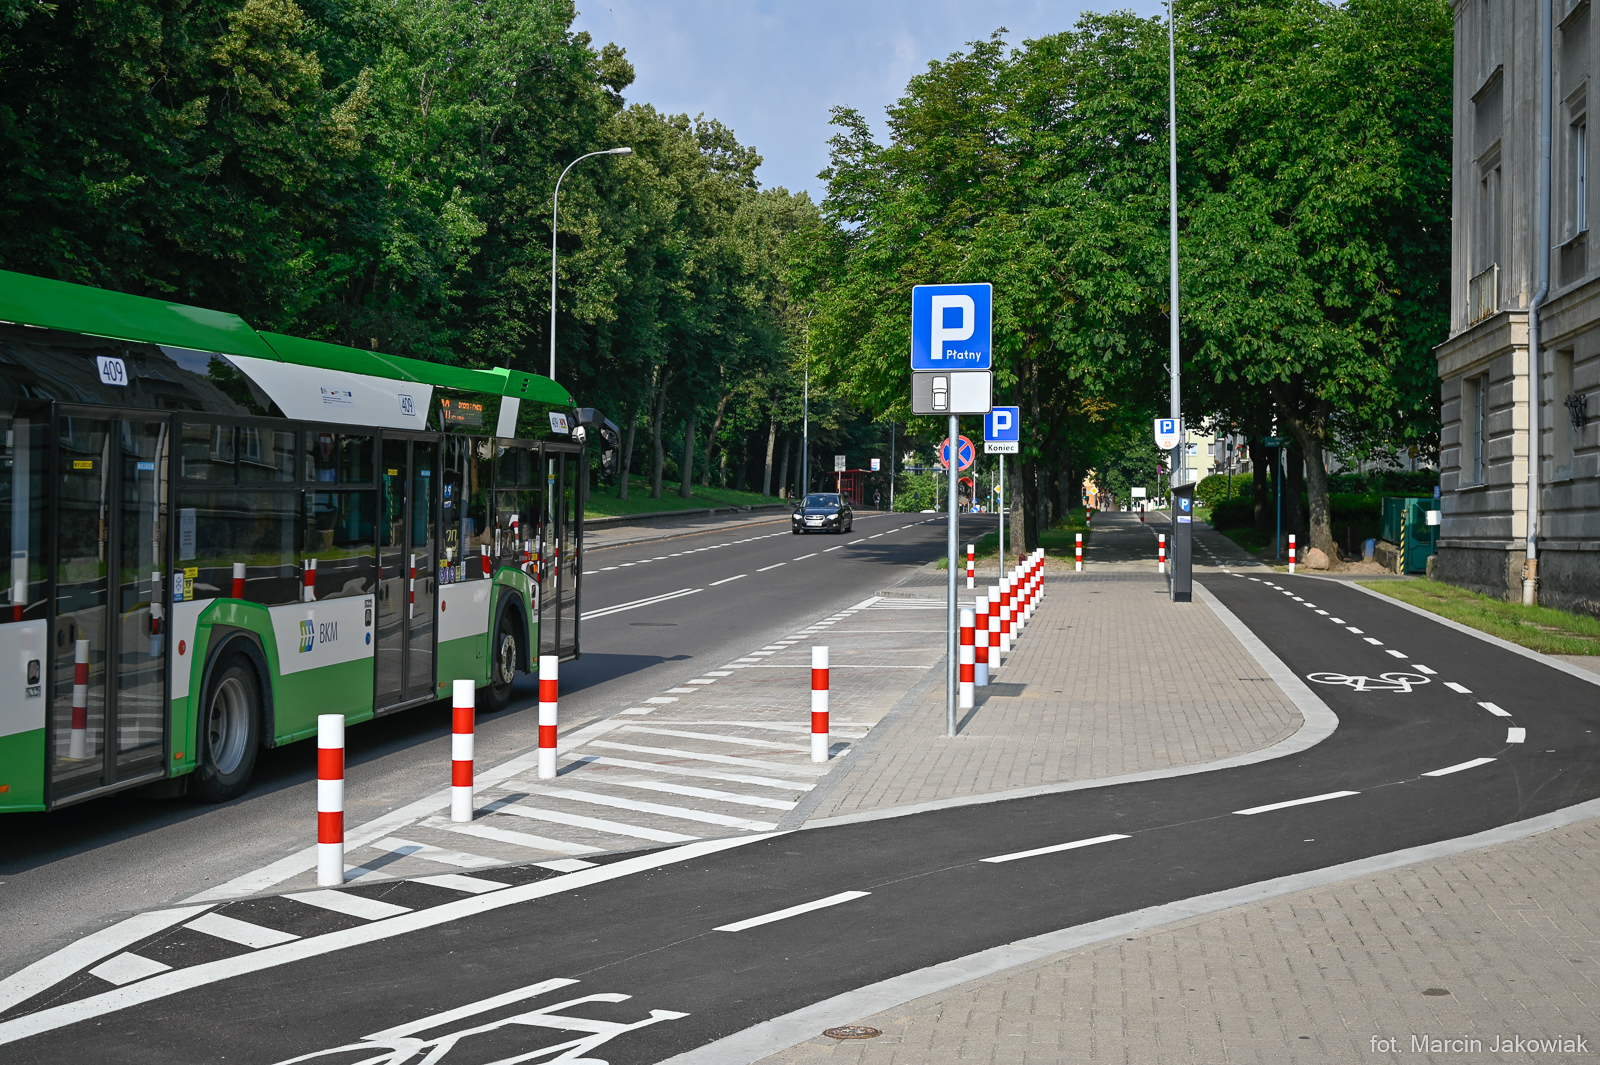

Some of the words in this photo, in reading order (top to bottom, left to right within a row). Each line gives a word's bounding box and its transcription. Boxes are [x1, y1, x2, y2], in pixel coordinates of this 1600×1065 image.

[931, 294, 975, 360] P
[946, 349, 982, 362] Płatny
[103, 360, 123, 382] 409
[401, 397, 413, 413] 409
[992, 410, 1012, 438] P
[987, 444, 1015, 452] Koniec
[320, 621, 338, 644] BKM
